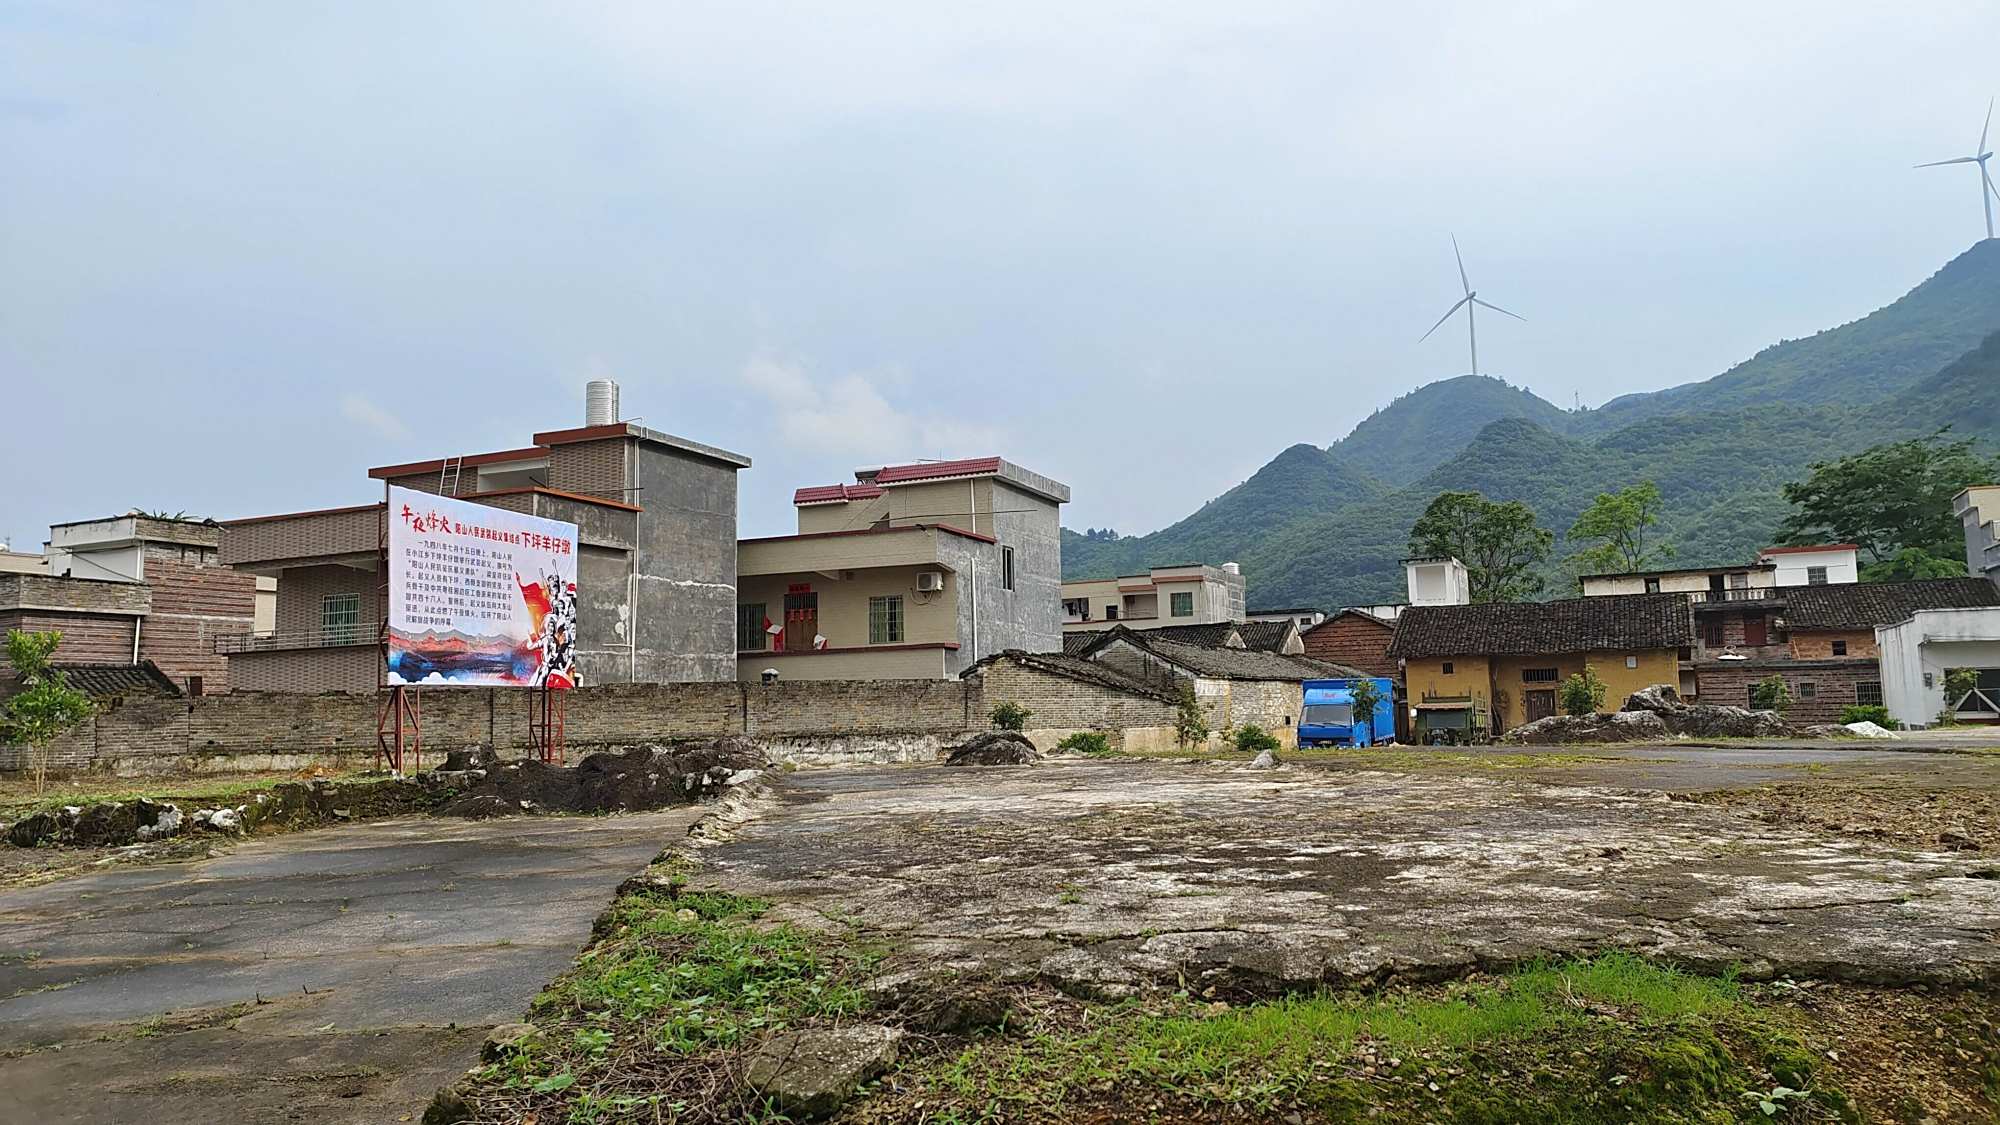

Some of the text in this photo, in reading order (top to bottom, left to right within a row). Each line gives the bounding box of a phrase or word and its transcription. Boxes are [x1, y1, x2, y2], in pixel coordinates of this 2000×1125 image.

[401, 503, 452, 534] 午夜烽火
[521, 531, 571, 554] 下坪羊仔墩
